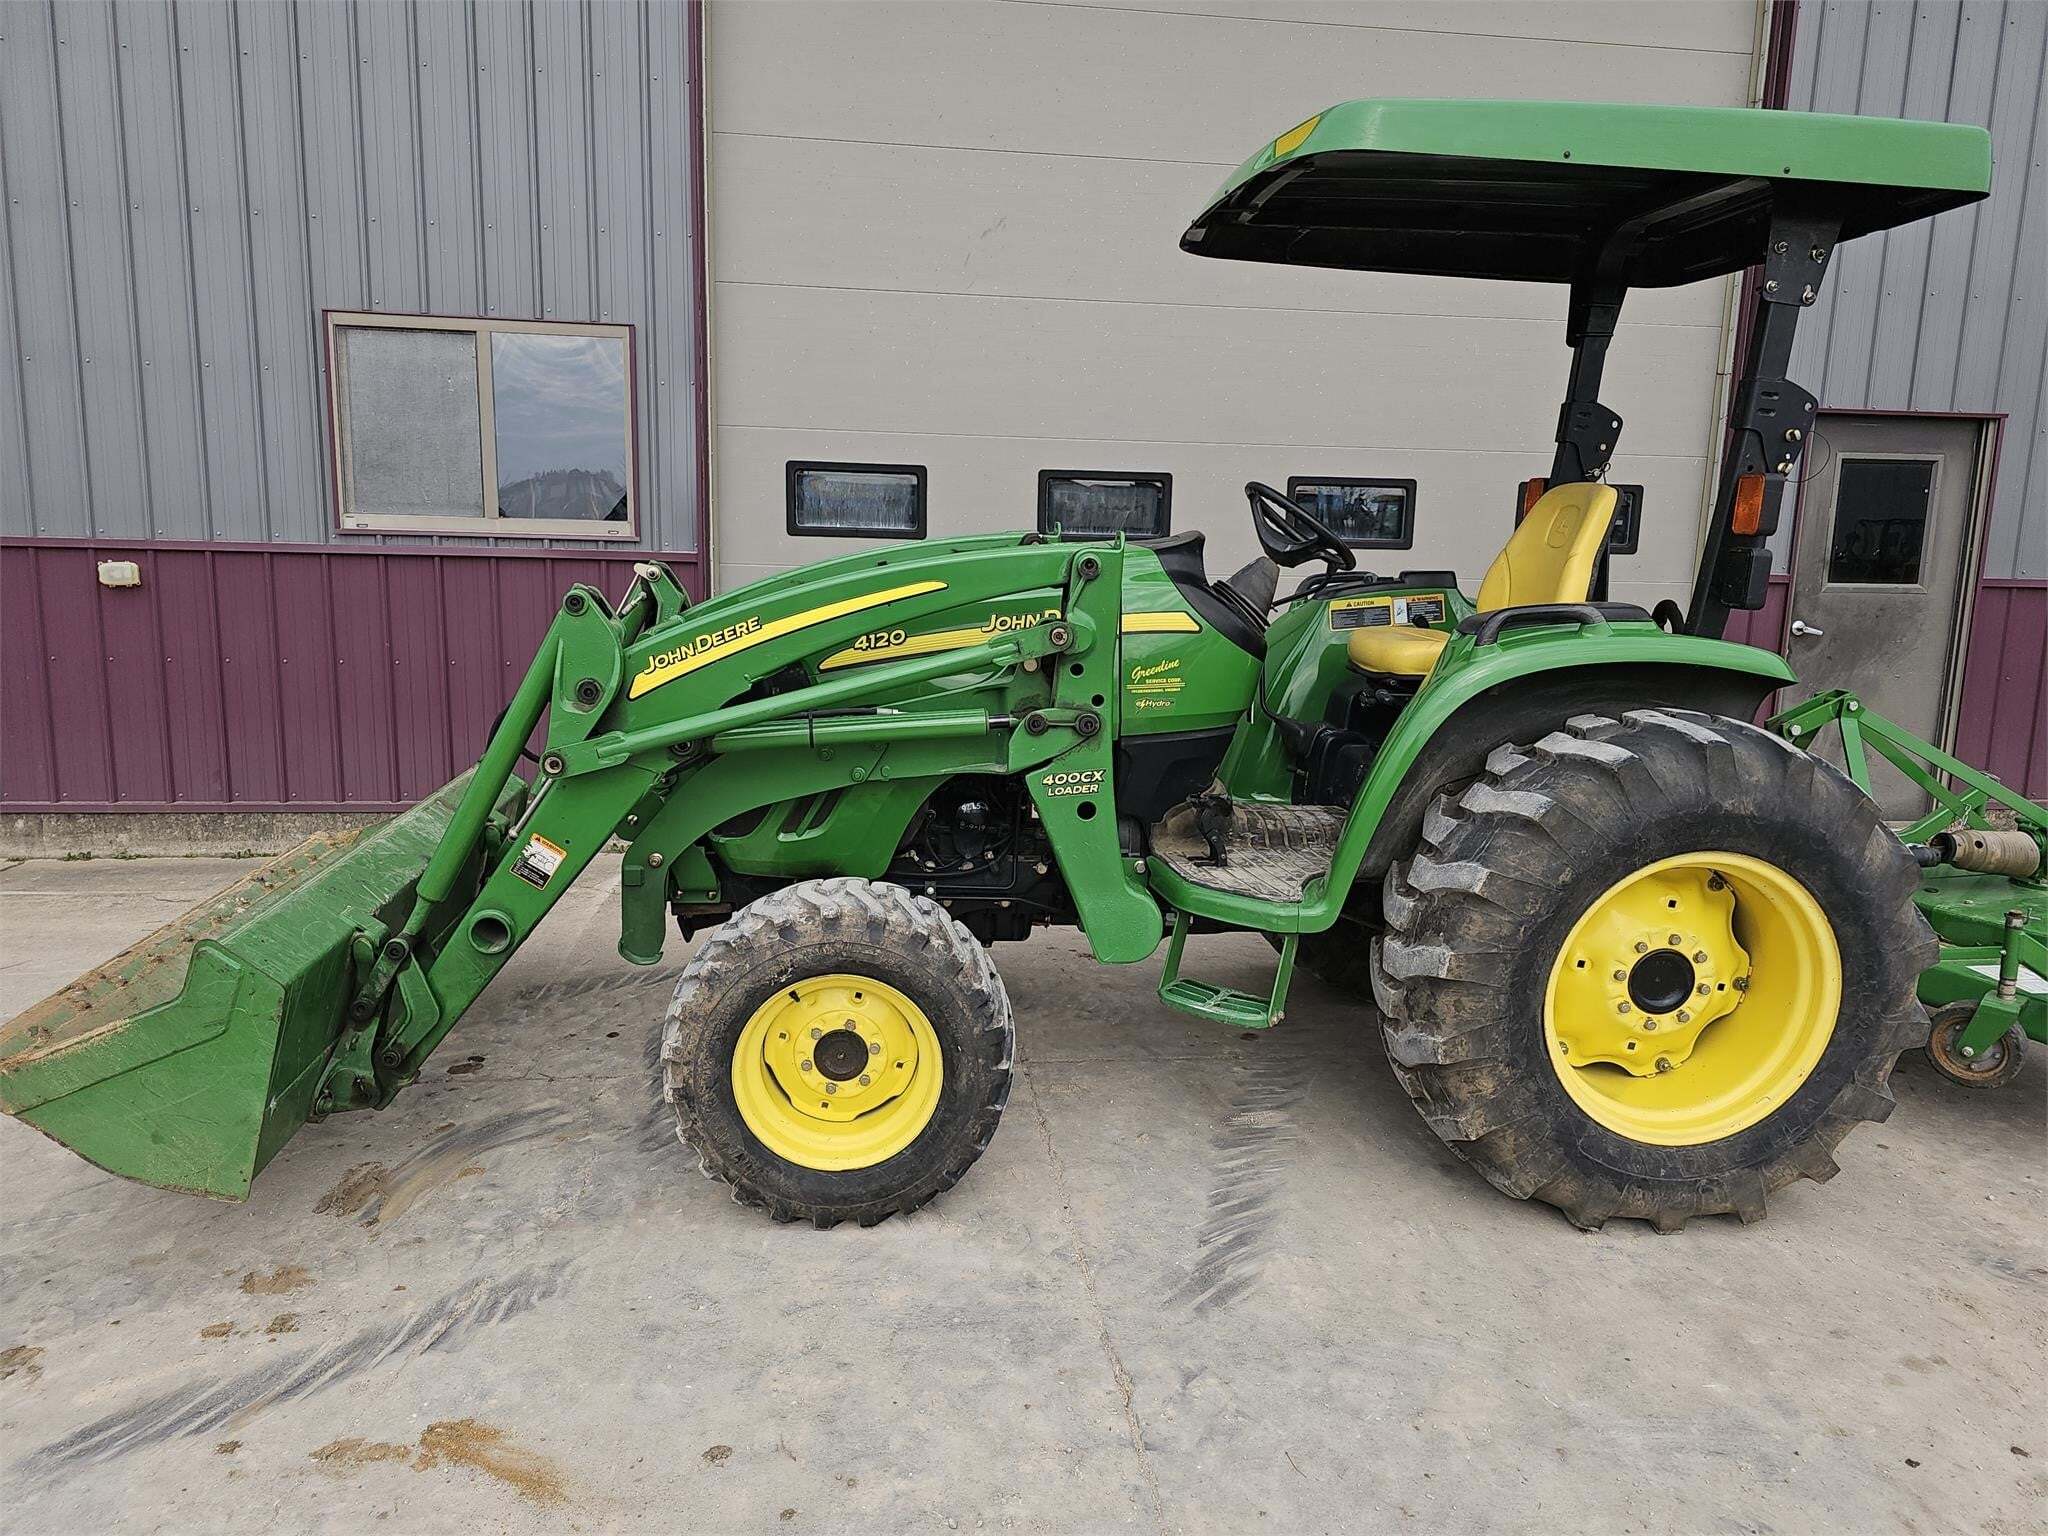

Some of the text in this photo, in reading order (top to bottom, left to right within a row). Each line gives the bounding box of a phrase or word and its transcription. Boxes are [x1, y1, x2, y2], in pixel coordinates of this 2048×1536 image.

[981, 613, 1041, 633] JOHN
[643, 616, 761, 674] JOHN DEERE
[854, 629, 906, 650] 4120
[1131, 658, 1180, 684] Greenline
[1042, 769, 1105, 786] 400CX
[1047, 784, 1099, 796] LOADER
